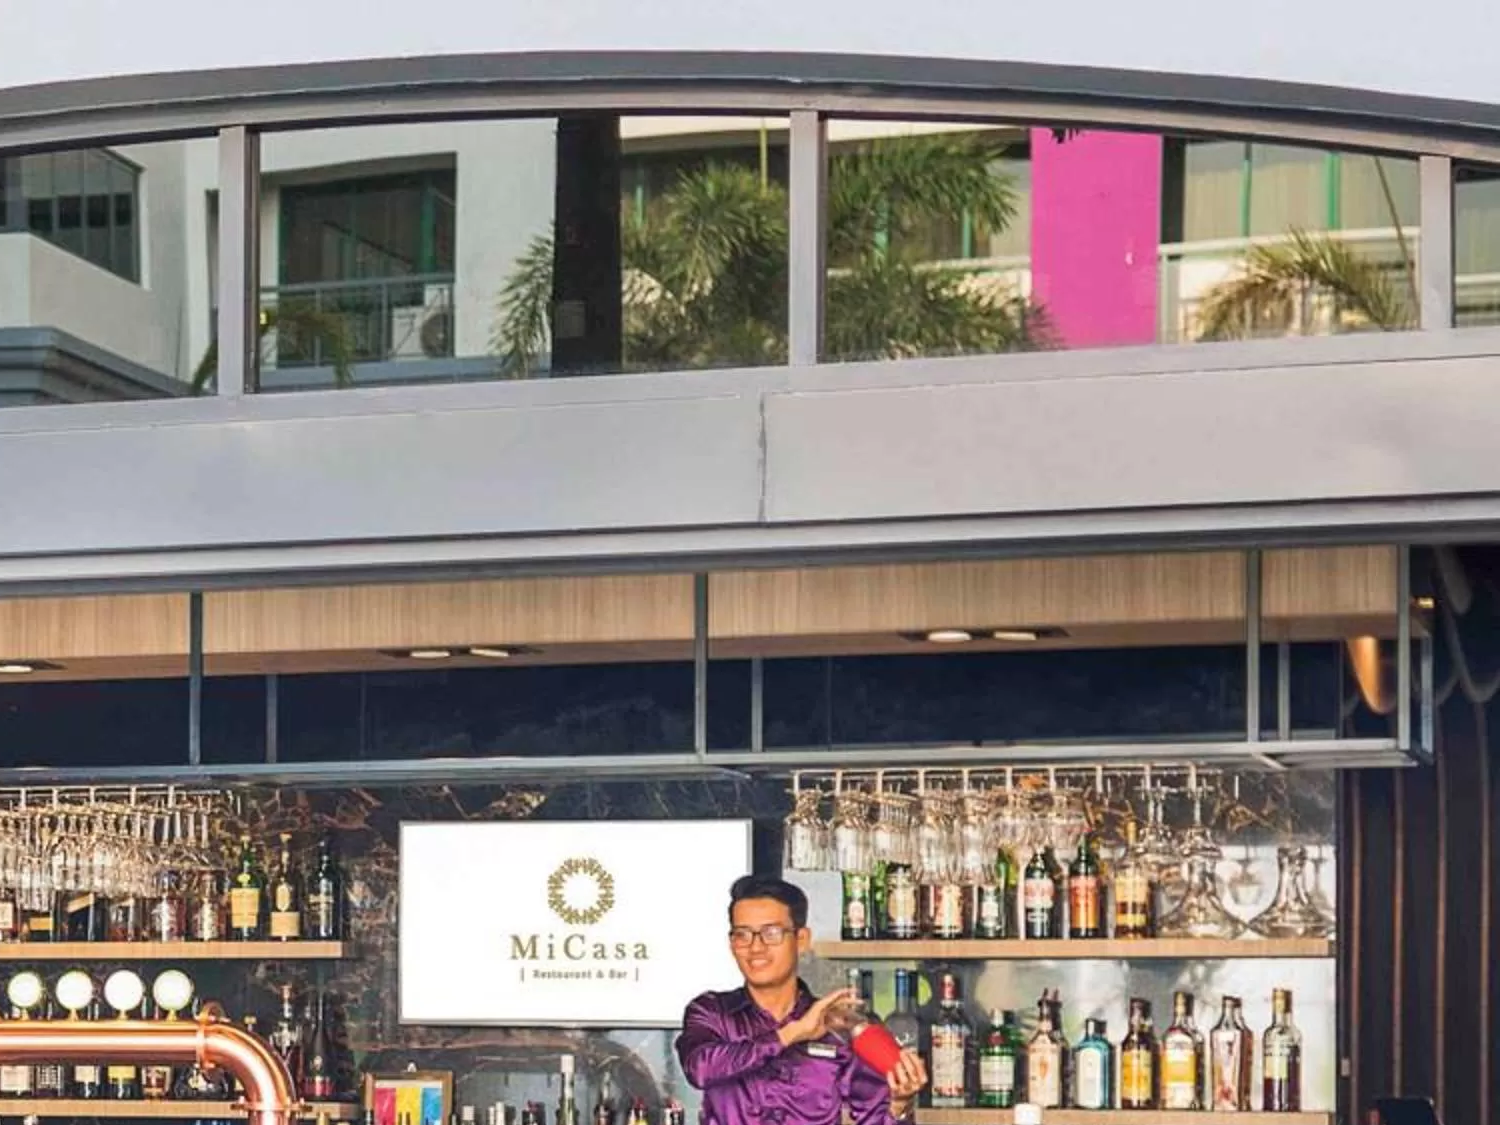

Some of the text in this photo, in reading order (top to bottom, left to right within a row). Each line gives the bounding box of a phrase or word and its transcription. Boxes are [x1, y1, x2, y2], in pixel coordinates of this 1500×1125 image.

[509, 932, 649, 961] MiCasa
[531, 968, 628, 980] Restaurant & Bar
